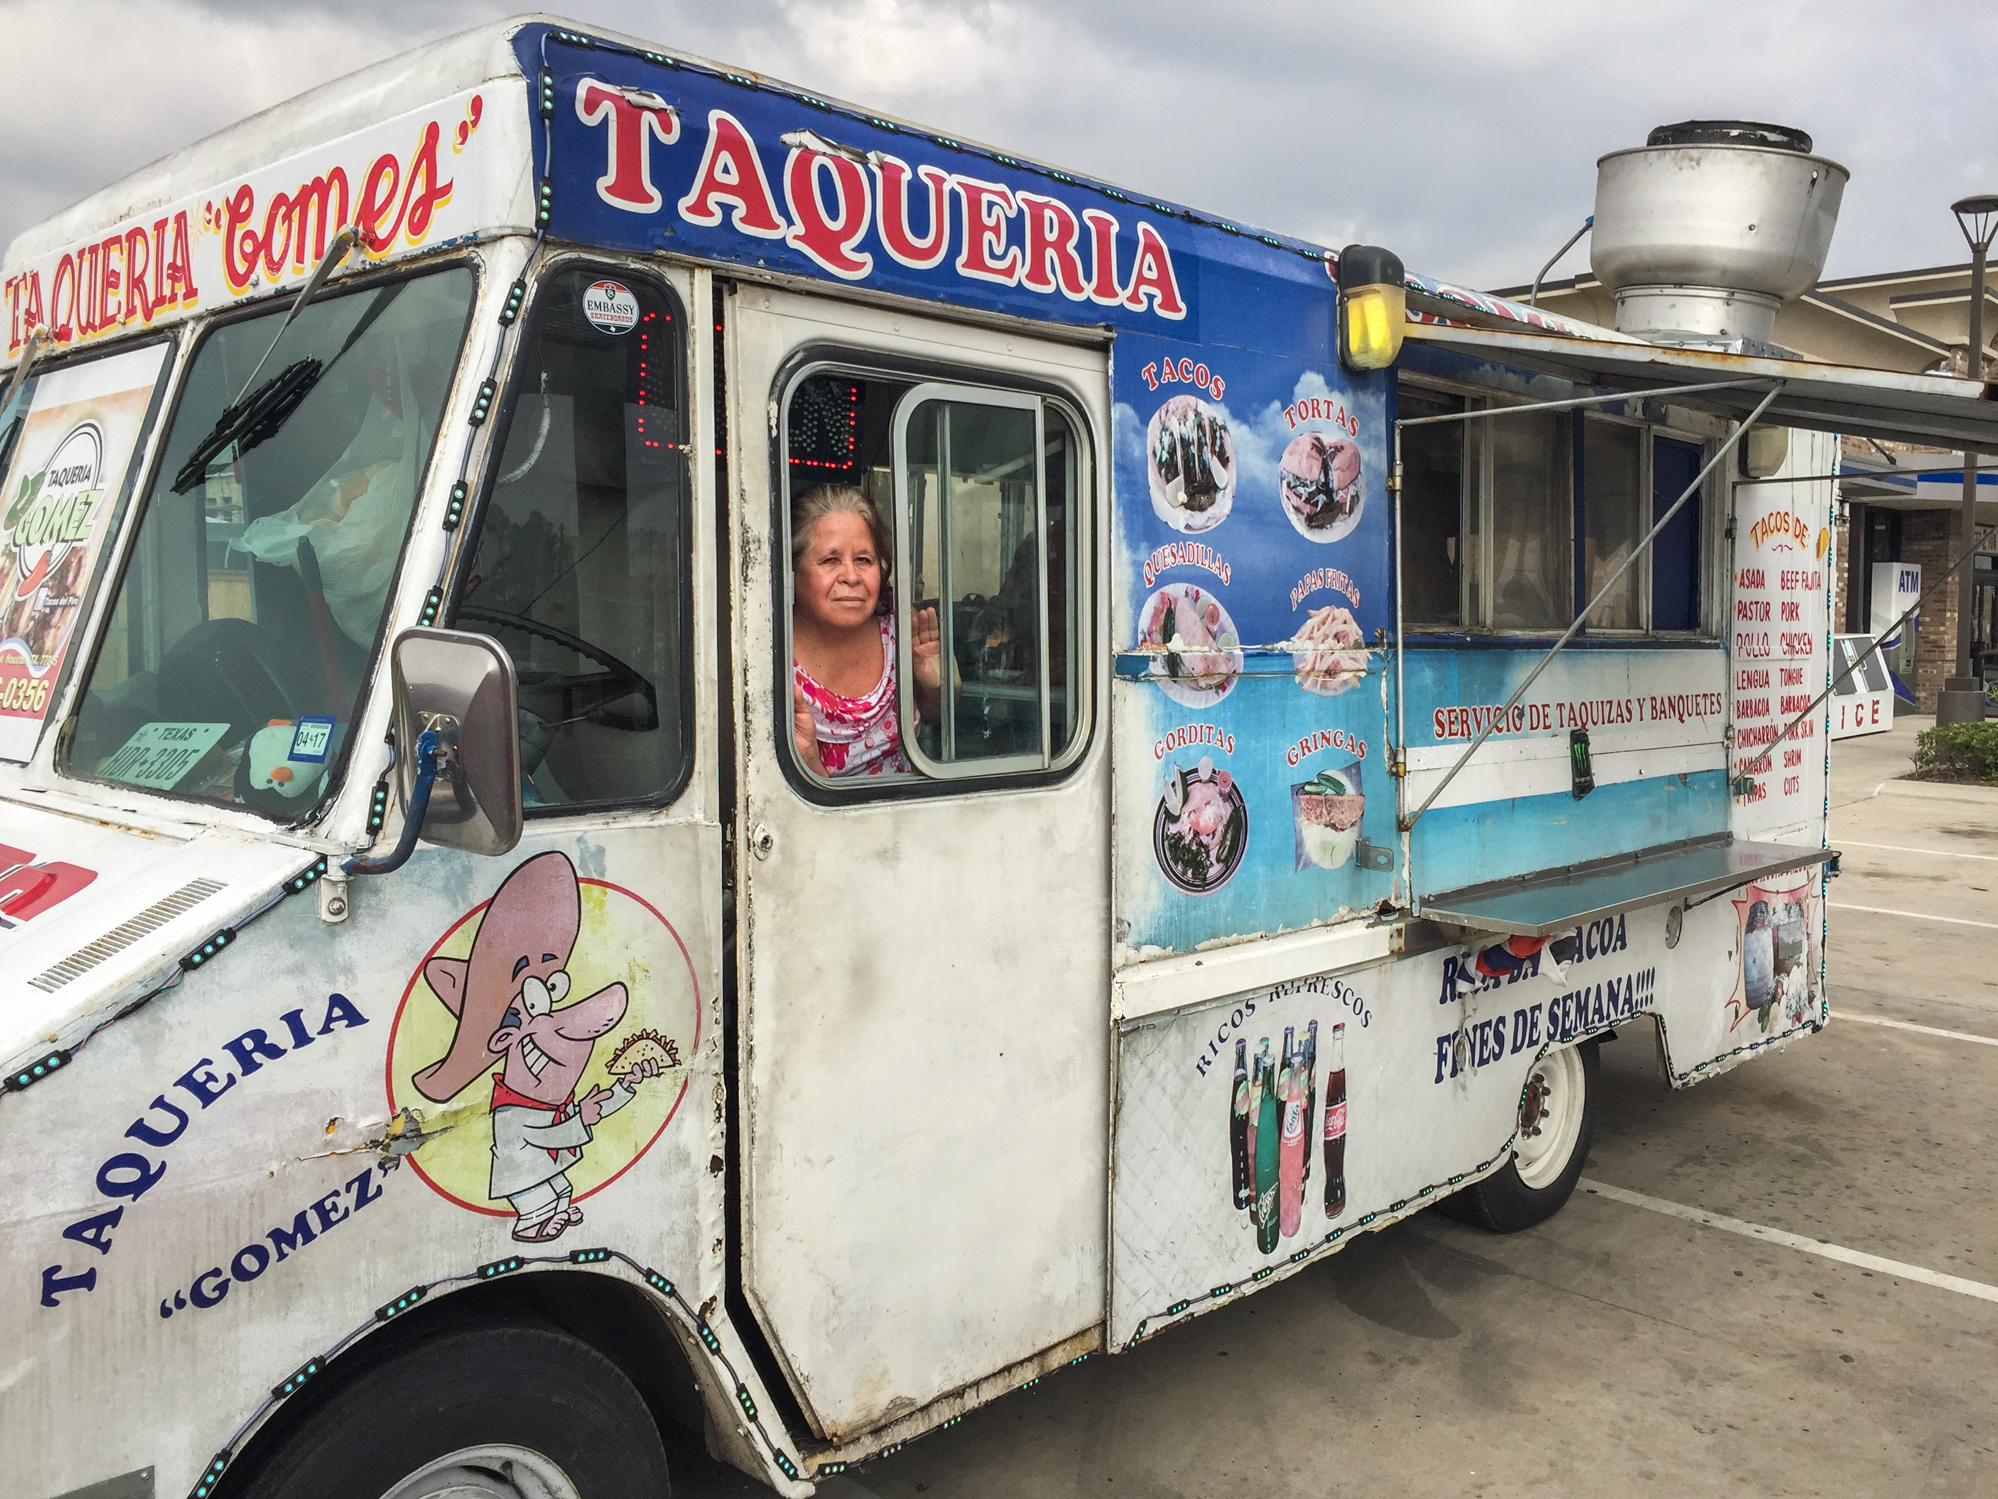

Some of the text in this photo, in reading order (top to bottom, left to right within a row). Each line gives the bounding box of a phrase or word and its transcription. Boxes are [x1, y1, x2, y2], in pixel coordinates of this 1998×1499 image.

[575, 77, 1187, 321] TAQUERIA
[587, 300, 635, 315] EMBASSY
[590, 312, 633, 323] SKATEBOARDS
[1142, 357, 1226, 400] TACOS
[1284, 398, 1360, 438] TORTAS
[47, 463, 91, 489] TAQUERIA
[13, 489, 104, 546] GOMEZ
[1750, 511, 1790, 552] TACOS
[1143, 541, 1231, 588] QUESADILLAS
[1739, 568, 1821, 591] ASADA BEEF FAJITA
[1898, 570, 1919, 593] ATM
[1290, 568, 1360, 611] PAPAS FRITAS
[1737, 600, 1800, 622] PASTOR PORK
[1736, 632, 1813, 658] POLLO CHICKEN
[0, 677, 49, 712] -0356
[1736, 668, 1803, 691] LENGUA TONGUE
[1434, 692, 1722, 740] SERVICIO DE TAQUIZAS Y BANQUETES
[1736, 697, 1770, 719] BARBACOA
[1841, 699, 1880, 730] ICE
[157, 727, 198, 742] TEXAS
[1154, 724, 1235, 760] GORDITAS
[1287, 730, 1368, 766] GRINGAS
[1784, 775, 1799, 796] CUTS
[1195, 997, 1256, 1078] RICOS
[1269, 976, 1372, 1029] REFRESCOS
[1434, 1015, 1506, 1084] FINES
[1511, 1003, 1542, 1055] DE
[40, 993, 370, 1308] TAQUERIA
